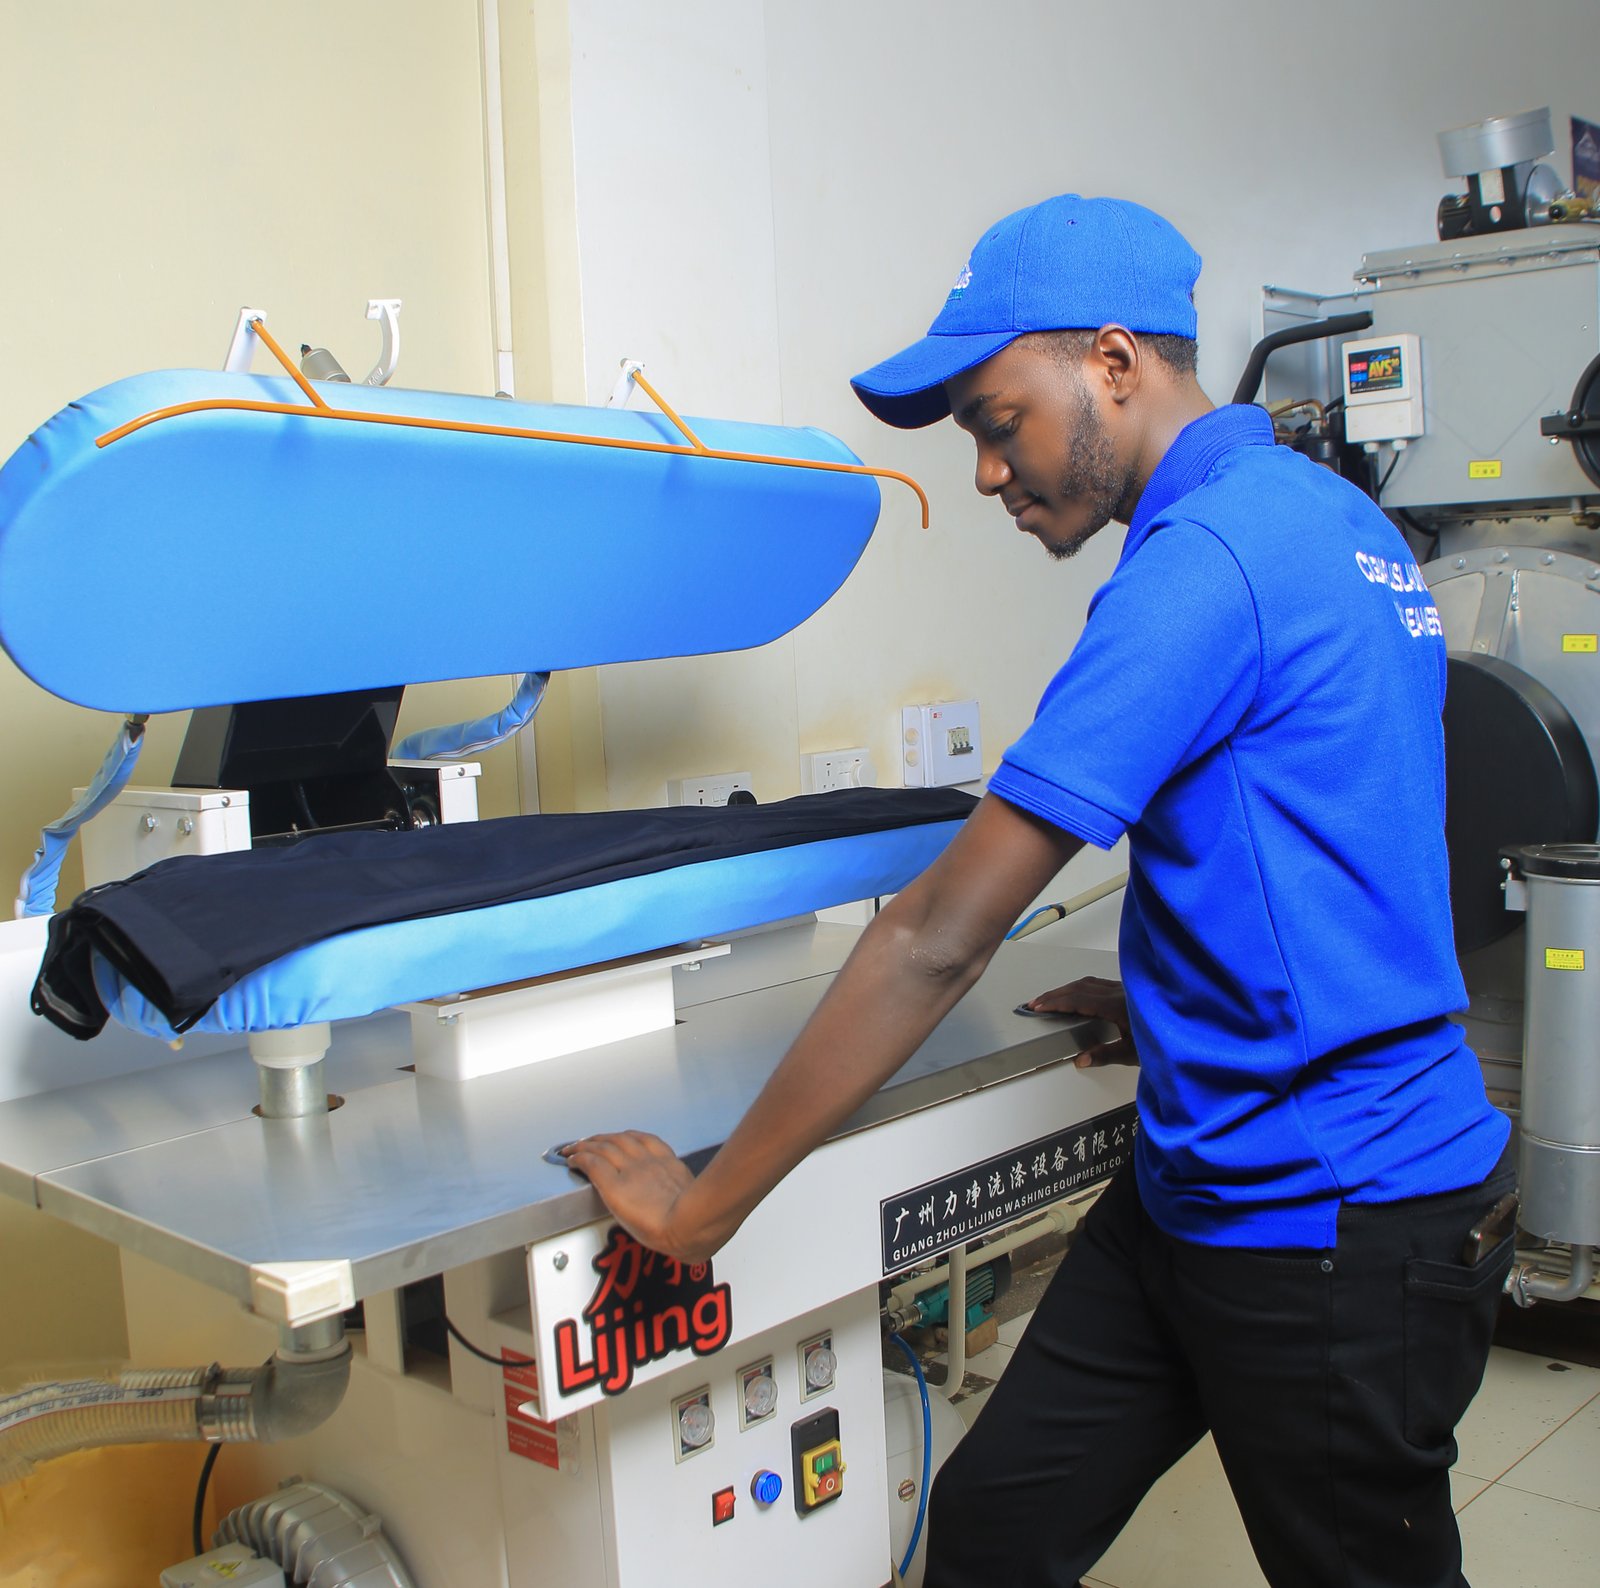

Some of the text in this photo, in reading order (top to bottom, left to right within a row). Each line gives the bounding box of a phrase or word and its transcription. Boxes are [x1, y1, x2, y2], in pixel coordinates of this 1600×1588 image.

[893, 1236, 934, 1262] GUANG
[936, 1222, 966, 1244] ZHOU
[968, 1206, 1002, 1230] LIJING
[1004, 1186, 1051, 1213] WASHING
[1053, 1162, 1108, 1192] EQUIPMENT
[558, 1288, 727, 1391] Lijing
